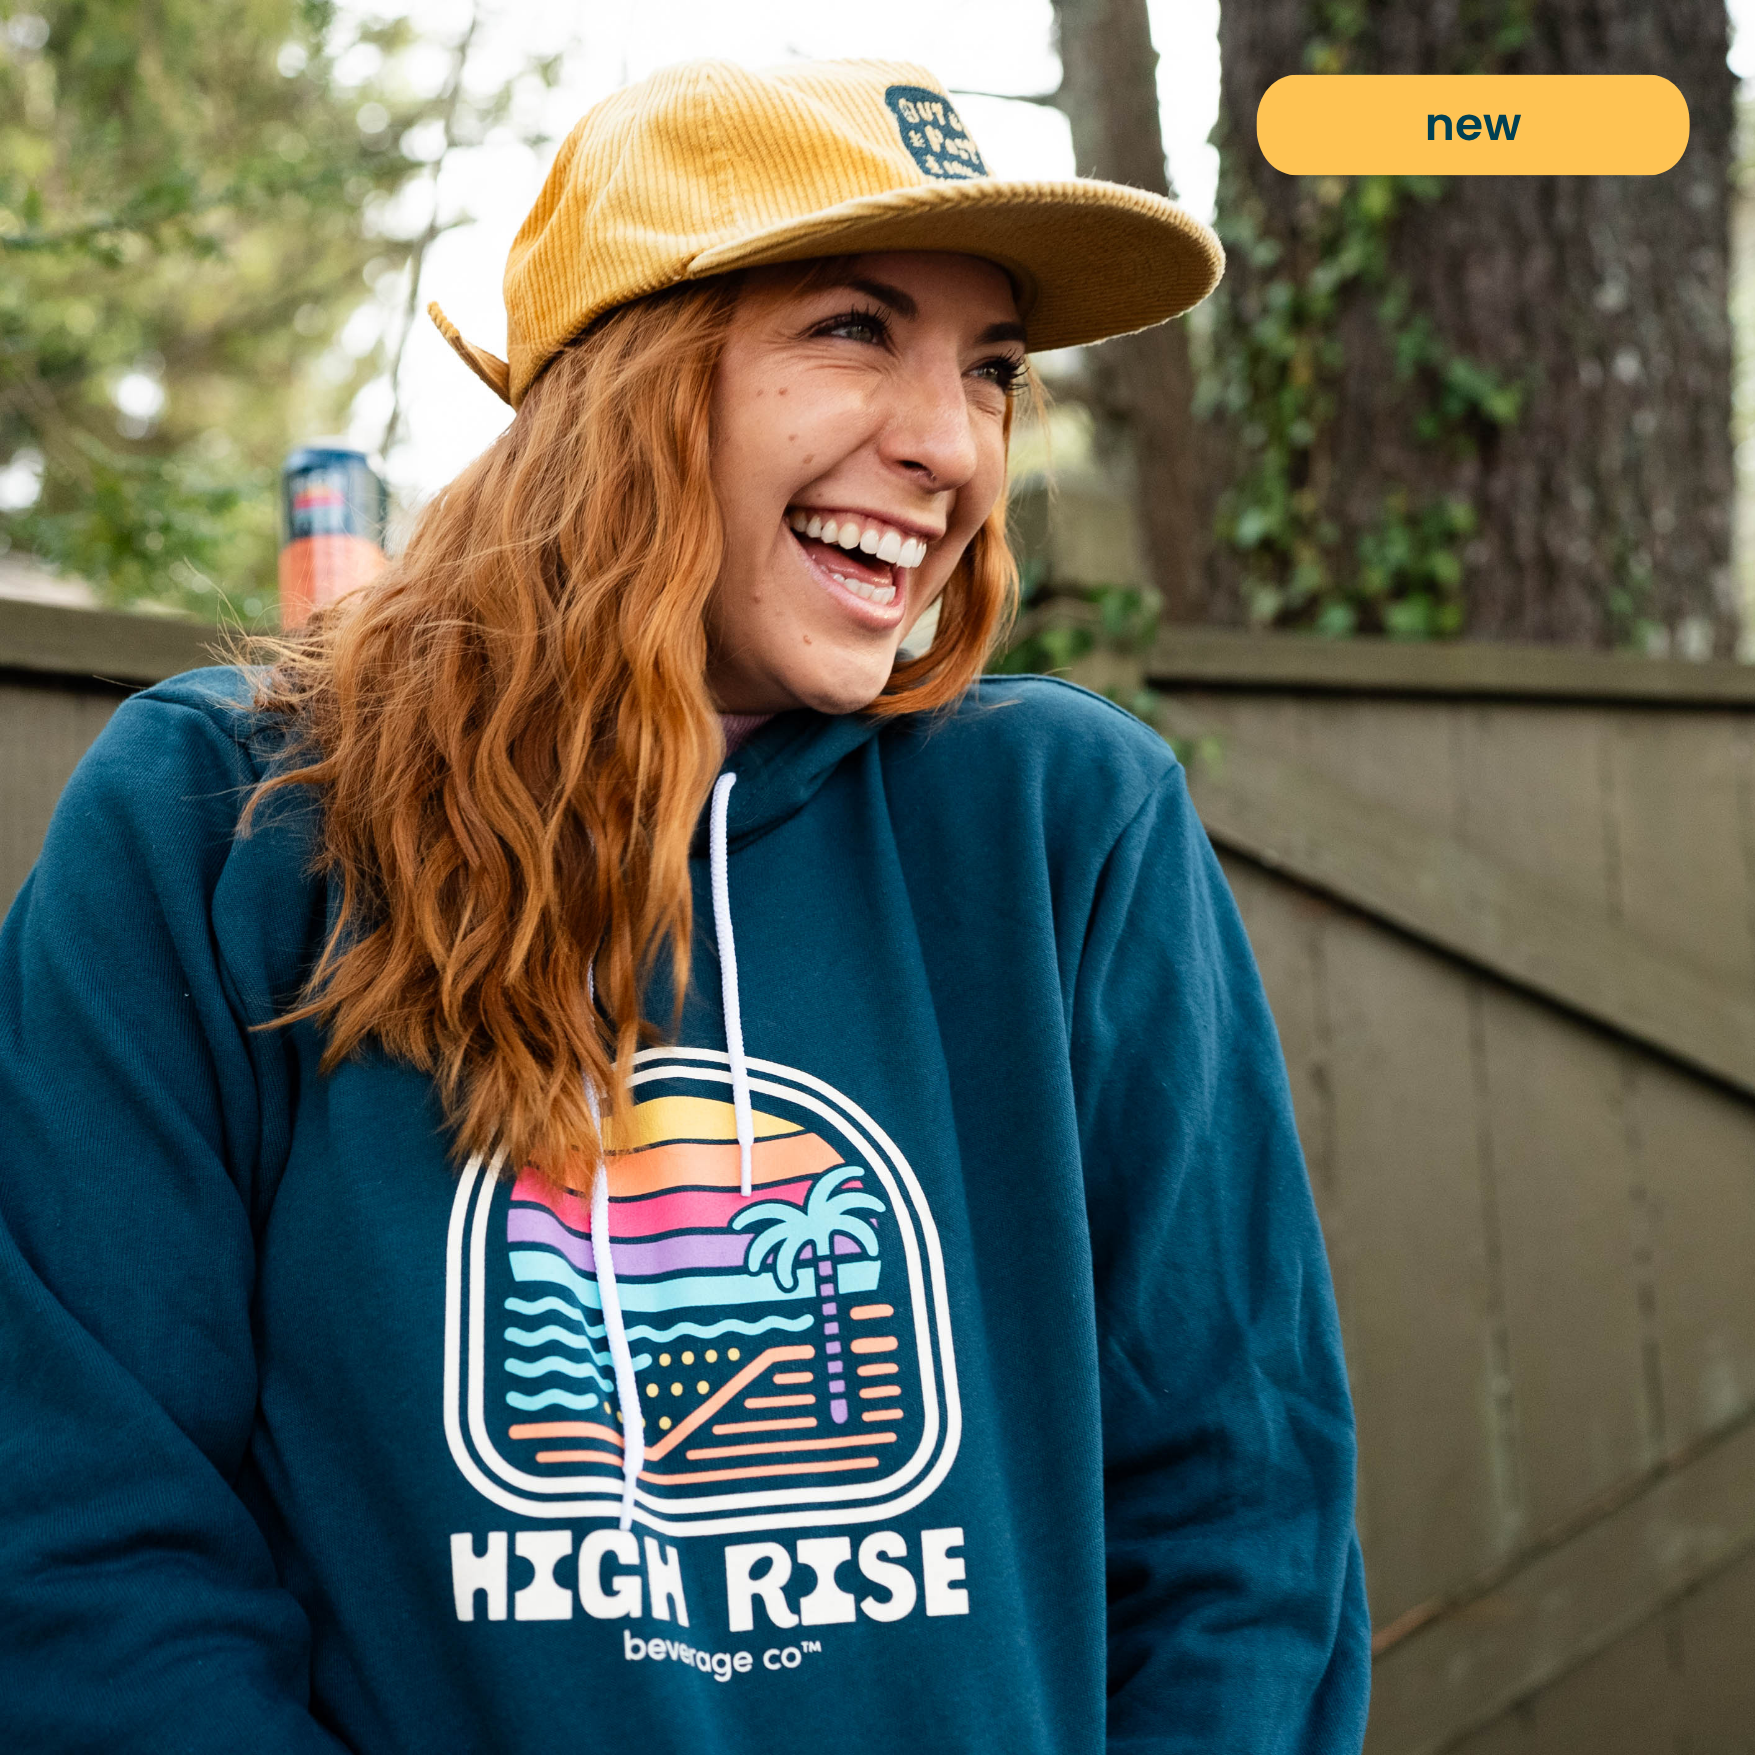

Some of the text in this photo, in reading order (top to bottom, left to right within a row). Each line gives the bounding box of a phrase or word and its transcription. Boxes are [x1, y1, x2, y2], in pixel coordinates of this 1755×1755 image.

[450, 1527, 971, 1633] HIGH RISE
[623, 1628, 753, 1683] beverage
